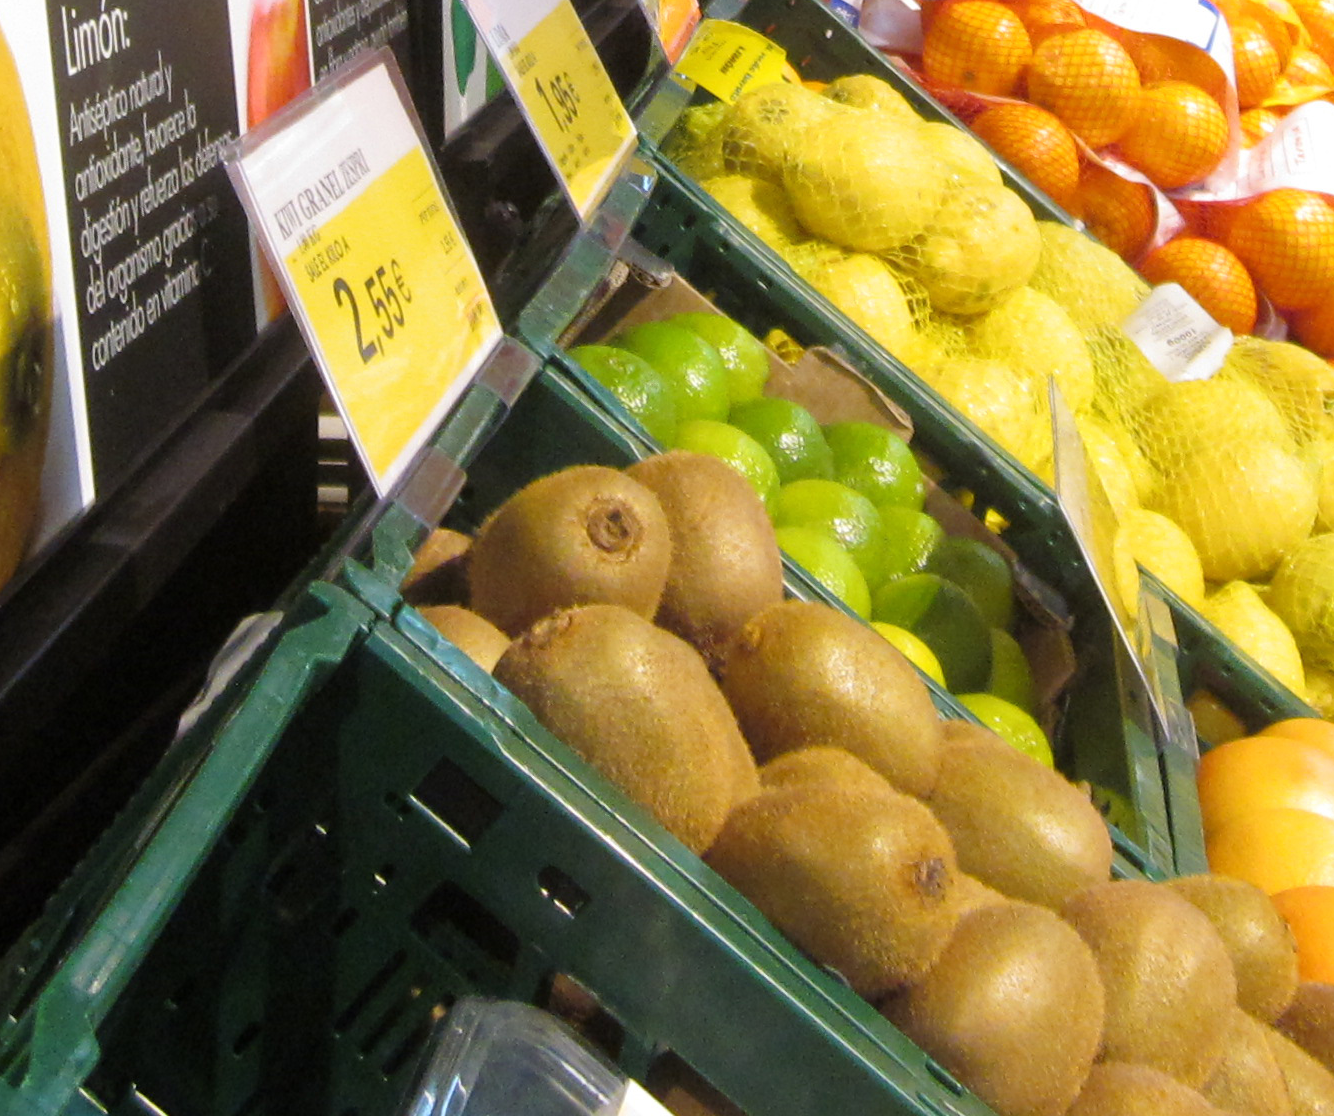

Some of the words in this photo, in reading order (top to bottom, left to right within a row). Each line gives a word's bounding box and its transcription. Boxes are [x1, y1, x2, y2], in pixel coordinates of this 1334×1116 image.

[69, 81, 128, 146] Antiséptico
[128, 50, 164, 115] natural
[163, 64, 173, 103] y
[143, 107, 186, 159] favorece
[80, 195, 132, 265] digestión
[131, 190, 141, 236] y
[139, 164, 180, 217] refuerza
[274, 200, 299, 242] KIWI
[297, 170, 346, 218] GRANEL
[86, 264, 106, 316] del
[105, 239, 163, 306] organismo
[332, 258, 413, 366] 2,55€
[92, 292, 146, 372] contenido
[145, 288, 161, 327] en
